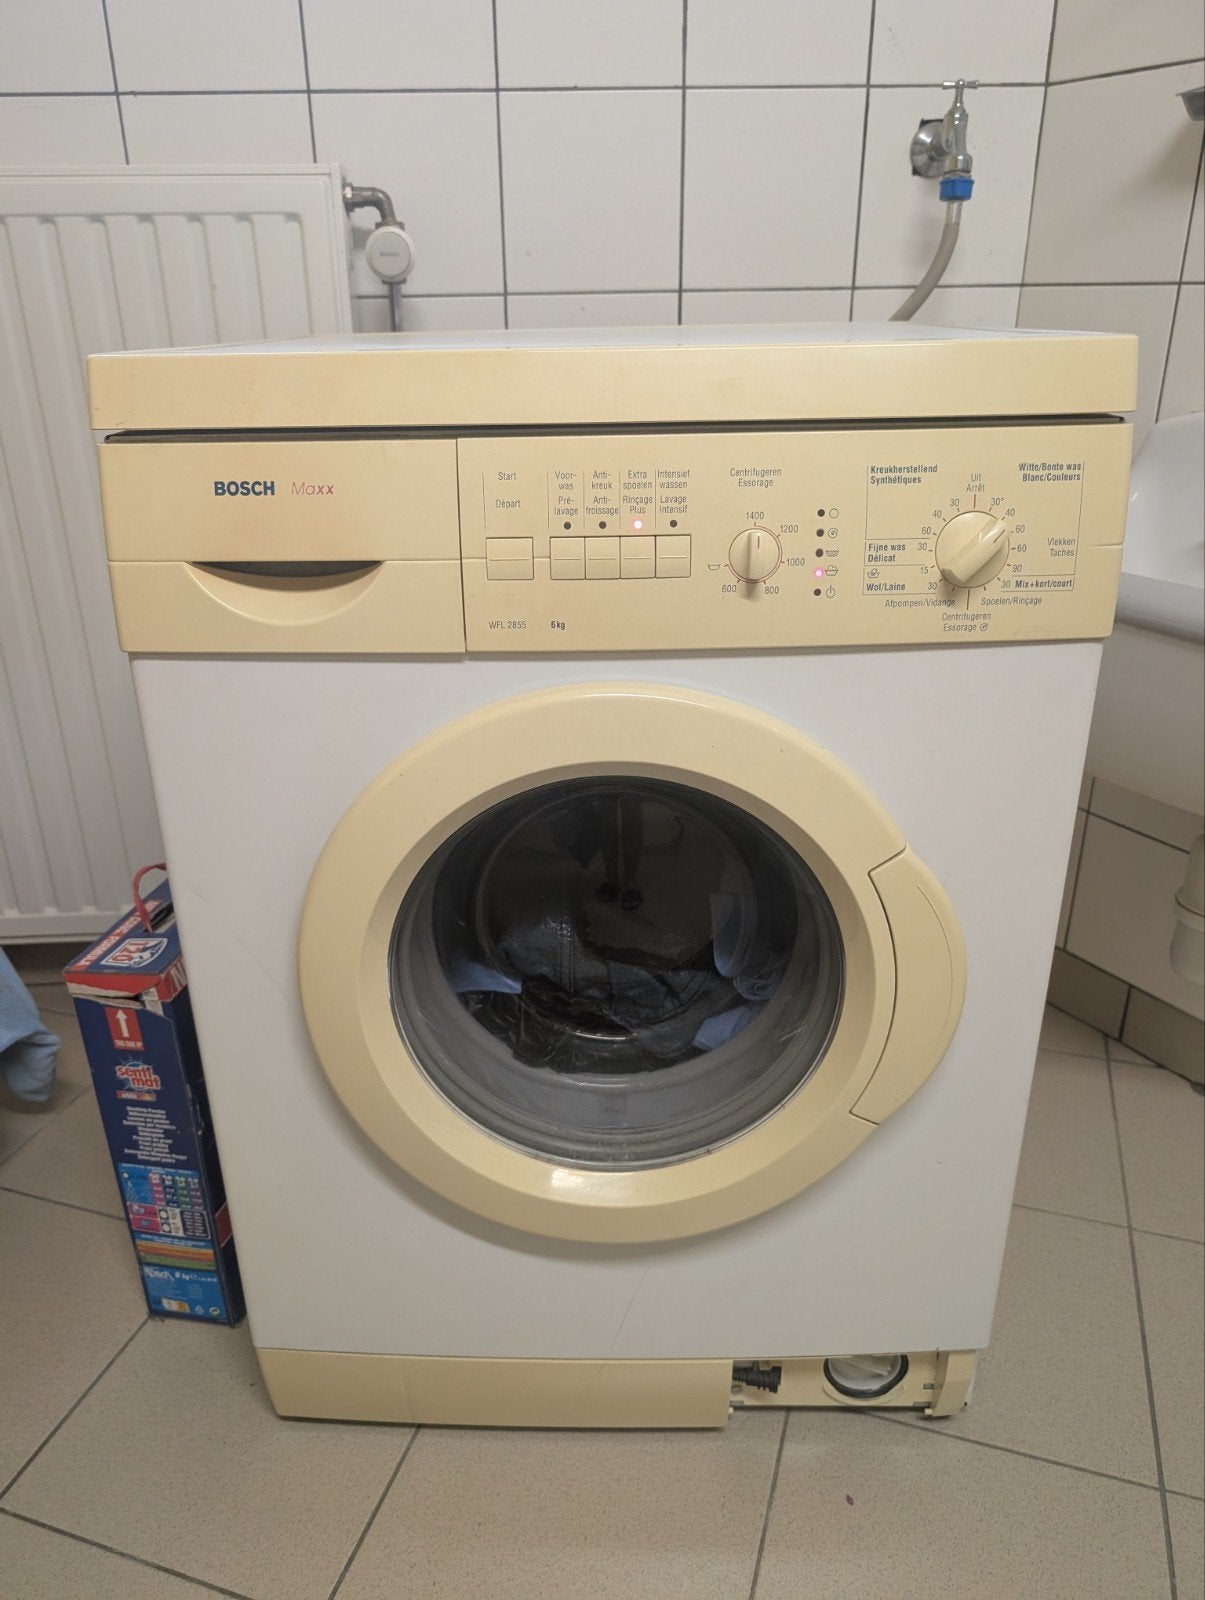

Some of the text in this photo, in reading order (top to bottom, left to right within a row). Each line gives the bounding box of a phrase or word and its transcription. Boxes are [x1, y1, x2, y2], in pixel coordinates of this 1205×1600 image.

[870, 465, 938, 474] Kreukherstellend
[1018, 462, 1082, 472] Witte/Bonte was
[498, 472, 517, 481] Start
[554, 471, 577, 481] Voor-
[593, 470, 610, 480] Anti-
[628, 470, 647, 479] Extra
[657, 469, 690, 479] Intensief
[730, 468, 782, 478] Centrifugeren
[971, 473, 982, 482] Uit
[1022, 473, 1080, 482] Blanc/Couleurs
[659, 481, 688, 489] wassen
[738, 478, 774, 488] Essorage
[870, 475, 922, 486] Synthétiques
[214, 480, 335, 496] BOSCH Maxx
[559, 482, 574, 490] was
[591, 481, 613, 490] kreuk
[623, 481, 652, 491] spoelen
[966, 483, 985, 492] Arrêt
[496, 499, 521, 509] Départ
[558, 496, 574, 505] Pré-
[593, 495, 610, 504] Anti-
[623, 495, 653, 506] Rinçage
[660, 495, 687, 504] Lavage
[950, 498, 960, 507] 30
[554, 506, 578, 516] lavage
[586, 506, 619, 516] froissage
[630, 505, 646, 514] Plus
[659, 505, 688, 514] Intensif
[932, 510, 942, 518] 40
[1005, 508, 1016, 517] 40
[746, 511, 764, 520] 1400
[780, 525, 799, 533] 1200
[921, 526, 932, 535] 60
[1015, 524, 1026, 534] 60
[1048, 537, 1076, 546] Vlekken
[868, 543, 890, 553] Fijne
[917, 543, 928, 551] 30
[1017, 544, 1027, 552] 60
[1050, 548, 1074, 557] Taches
[786, 558, 805, 566] 1000
[868, 554, 896, 563] Délicat
[920, 566, 929, 574] 15
[1012, 564, 1022, 573] 90
[722, 585, 737, 593] 600
[866, 583, 906, 592] Wol/Laine
[928, 582, 938, 590] 30
[1001, 580, 1011, 589] 30
[764, 586, 780, 594] 800
[884, 598, 956, 608] Afpompen/Vidange
[981, 596, 1043, 606] Spoelen/Rinçage
[942, 612, 991, 622] Centrifugeren
[489, 621, 527, 629] WFL 2855
[943, 623, 977, 632] Essorage
[116, 1064, 152, 1080] senti
[131, 1075, 161, 1090] mat
